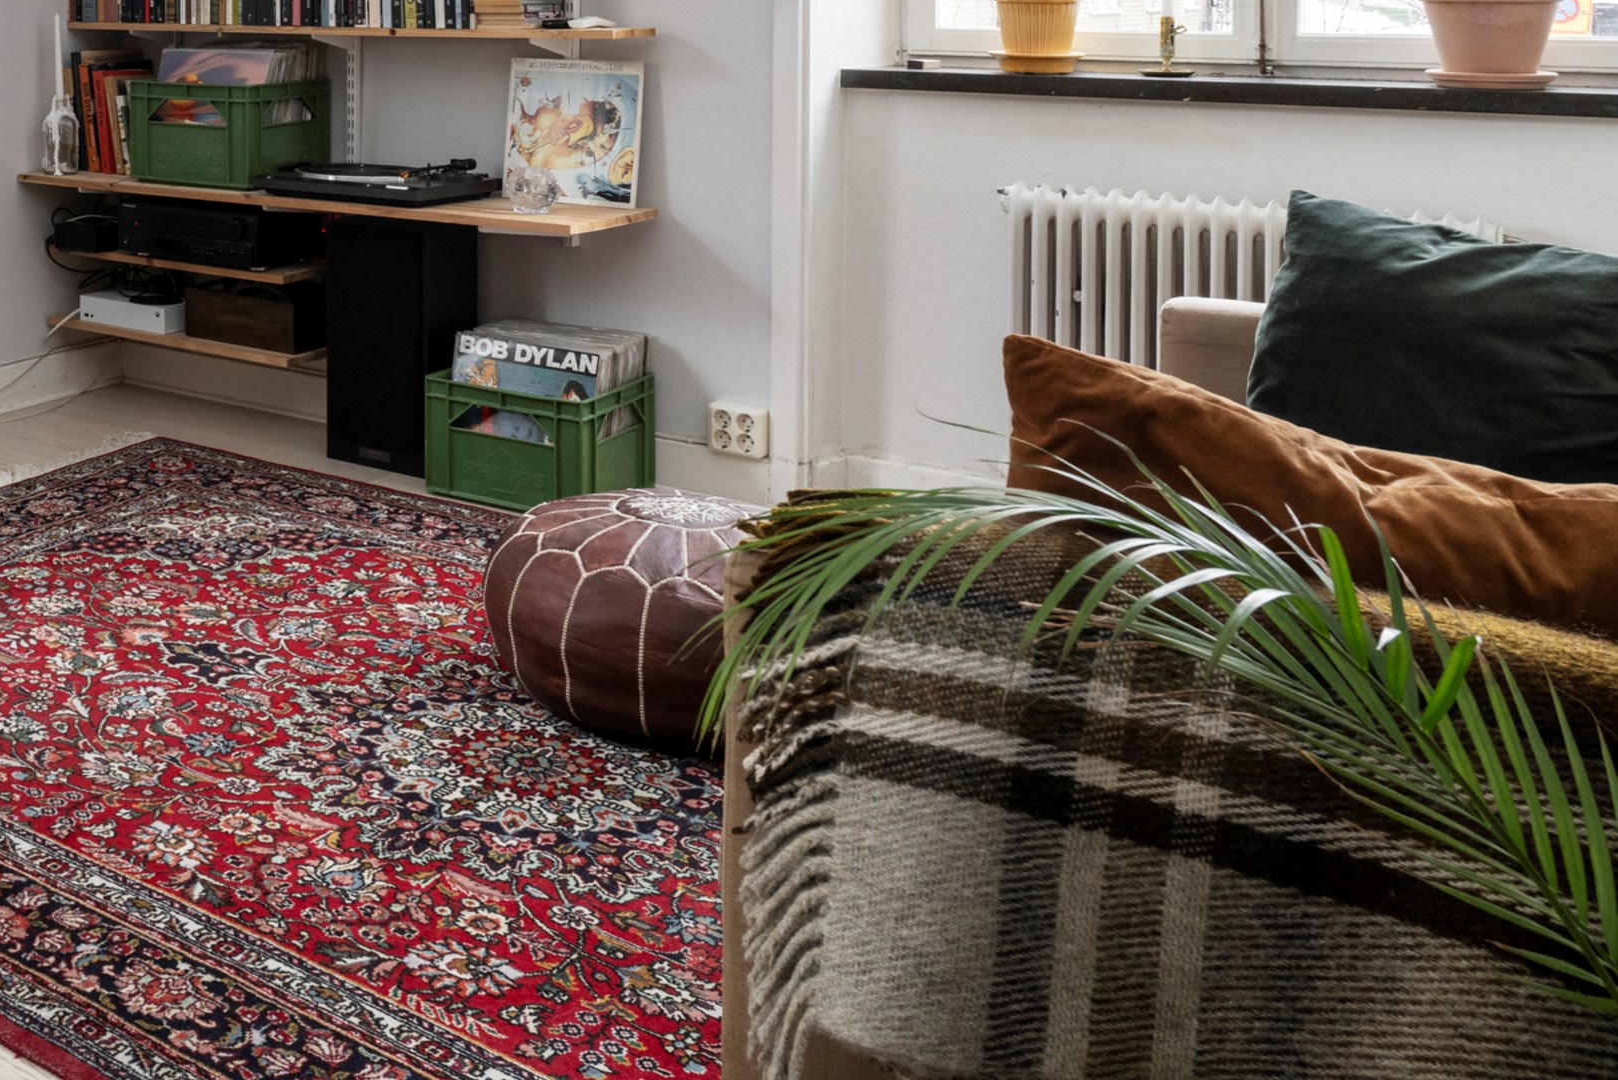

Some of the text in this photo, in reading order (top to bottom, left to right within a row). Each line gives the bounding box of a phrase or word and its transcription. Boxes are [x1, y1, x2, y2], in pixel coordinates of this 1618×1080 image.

[82, 82, 93, 124] BOB DYLAN
[459, 334, 599, 376] BOB DYLAN
